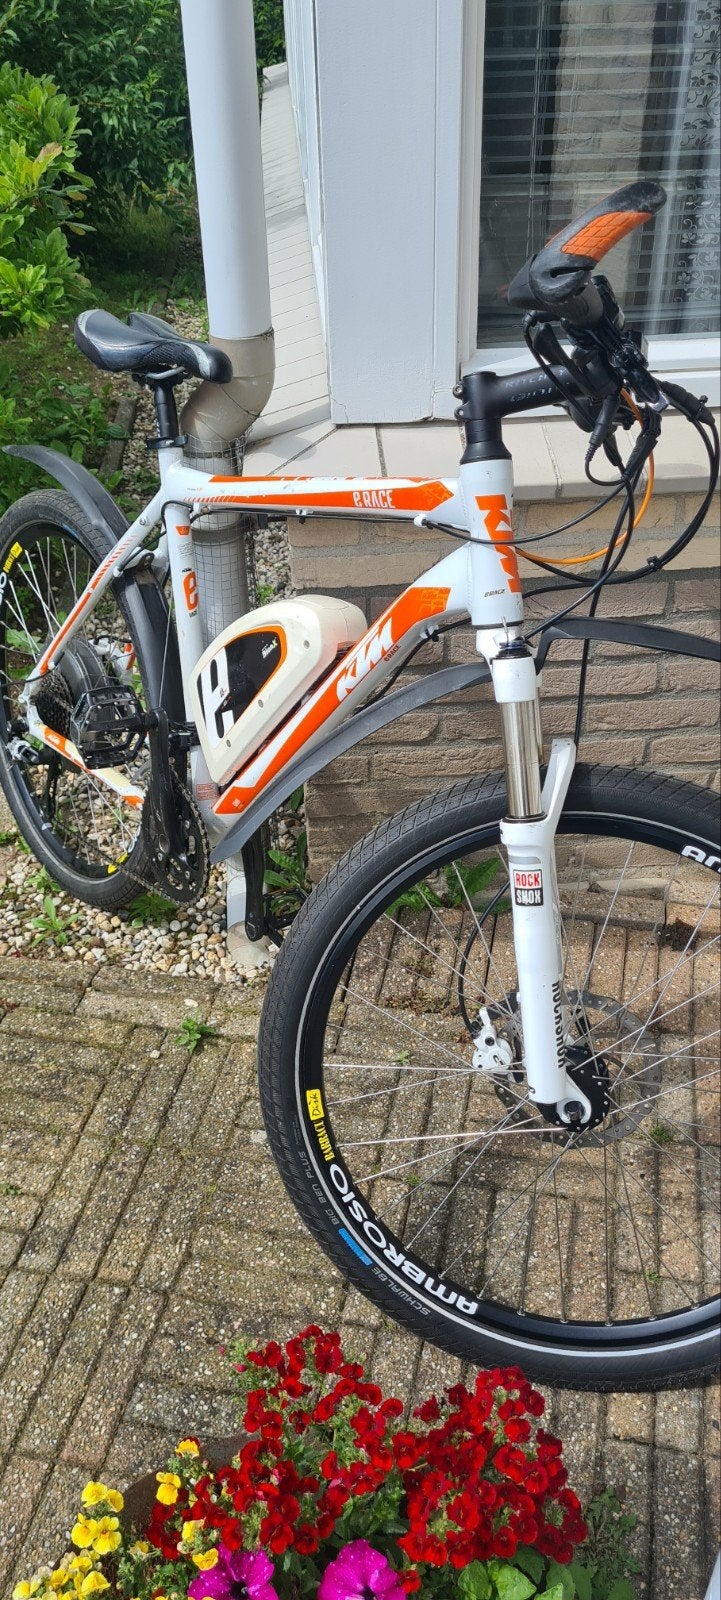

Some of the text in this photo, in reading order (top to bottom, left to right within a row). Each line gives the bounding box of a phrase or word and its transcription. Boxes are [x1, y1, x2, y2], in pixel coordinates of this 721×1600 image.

[336, 616, 394, 702] KTM
[515, 872, 541, 887] ROCK
[516, 889, 541, 904] SHOX
[298, 1150, 314, 1179] PLUS
[324, 1208, 340, 1225] BIG
[329, 1163, 479, 1315] AMBROSIO
[371, 1266, 431, 1316] SCHWALBE
